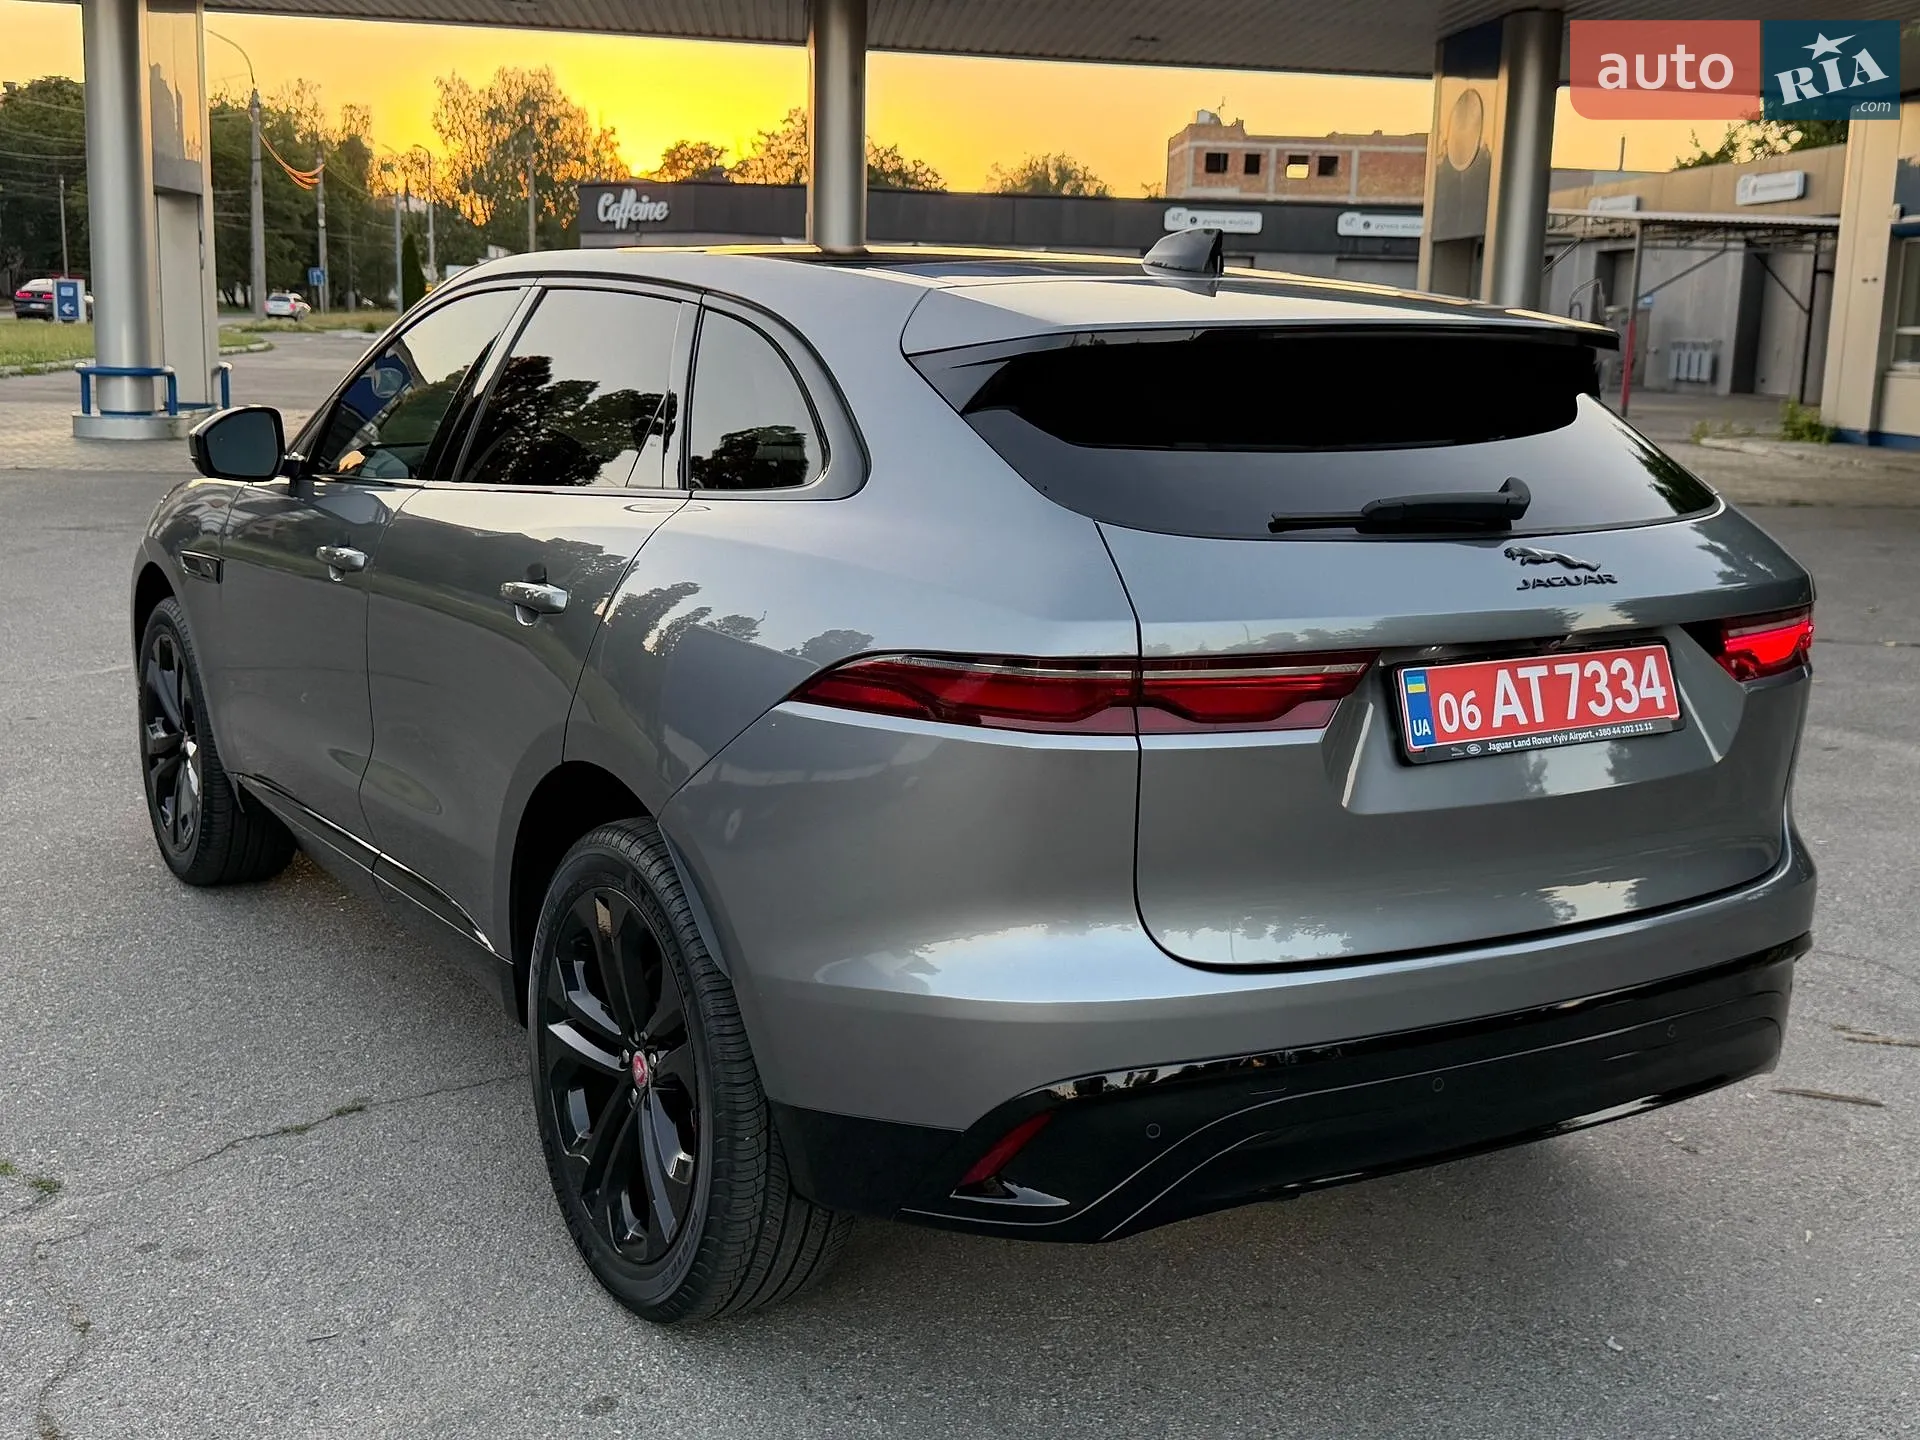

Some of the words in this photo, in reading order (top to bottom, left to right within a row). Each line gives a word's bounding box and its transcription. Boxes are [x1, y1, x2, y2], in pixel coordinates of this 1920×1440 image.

[597, 188, 671, 230] Caffeine
[1516, 574, 1619, 591] JAGUAR
[1438, 690, 1482, 733] 06
[1412, 718, 1432, 737] UA
[1487, 740, 1512, 752] Jaguar
[1513, 738, 1531, 748] Land
[1531, 736, 1552, 745] Rover
[1552, 734, 1568, 744] Kyiv
[1595, 728, 1611, 737] +380
[1612, 726, 1621, 735] 44
[1622, 725, 1634, 734] 202
[1634, 723, 1643, 732] 11
[1644, 722, 1653, 731] 11
